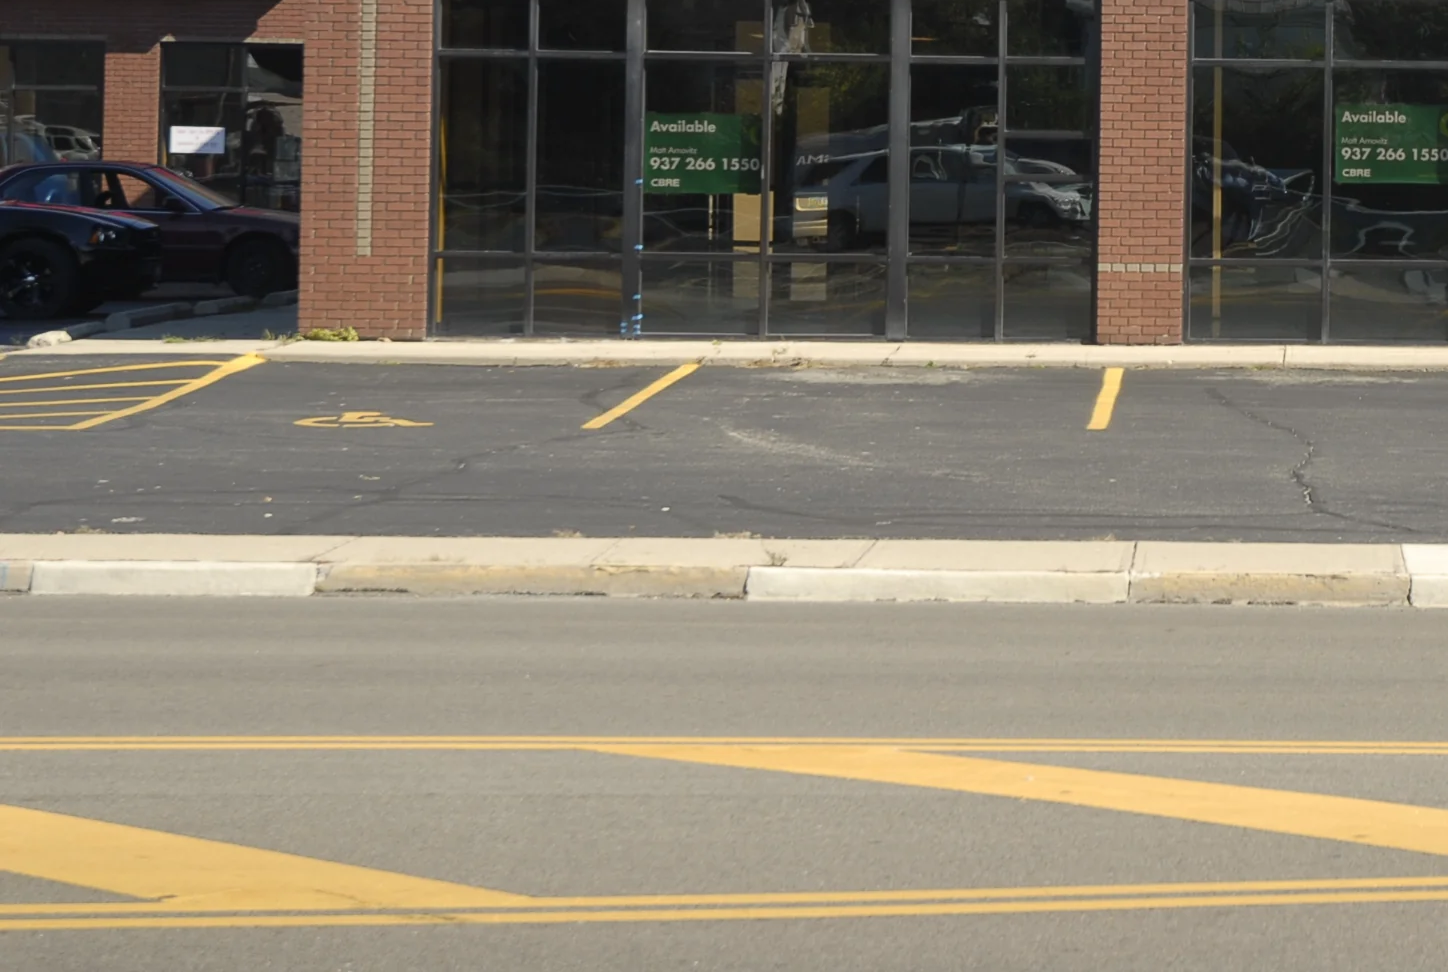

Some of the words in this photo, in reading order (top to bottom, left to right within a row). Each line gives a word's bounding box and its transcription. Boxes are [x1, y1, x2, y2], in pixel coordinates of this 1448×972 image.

[1341, 111, 1407, 124] Available
[650, 120, 717, 133] Available
[1341, 147, 1372, 160] 937
[1376, 148, 1406, 161] 266
[650, 157, 681, 170] 937
[685, 157, 716, 171] 266
[722, 158, 760, 171] 1550
[1342, 168, 1372, 177] CBRE
[650, 178, 681, 187] CBRE
